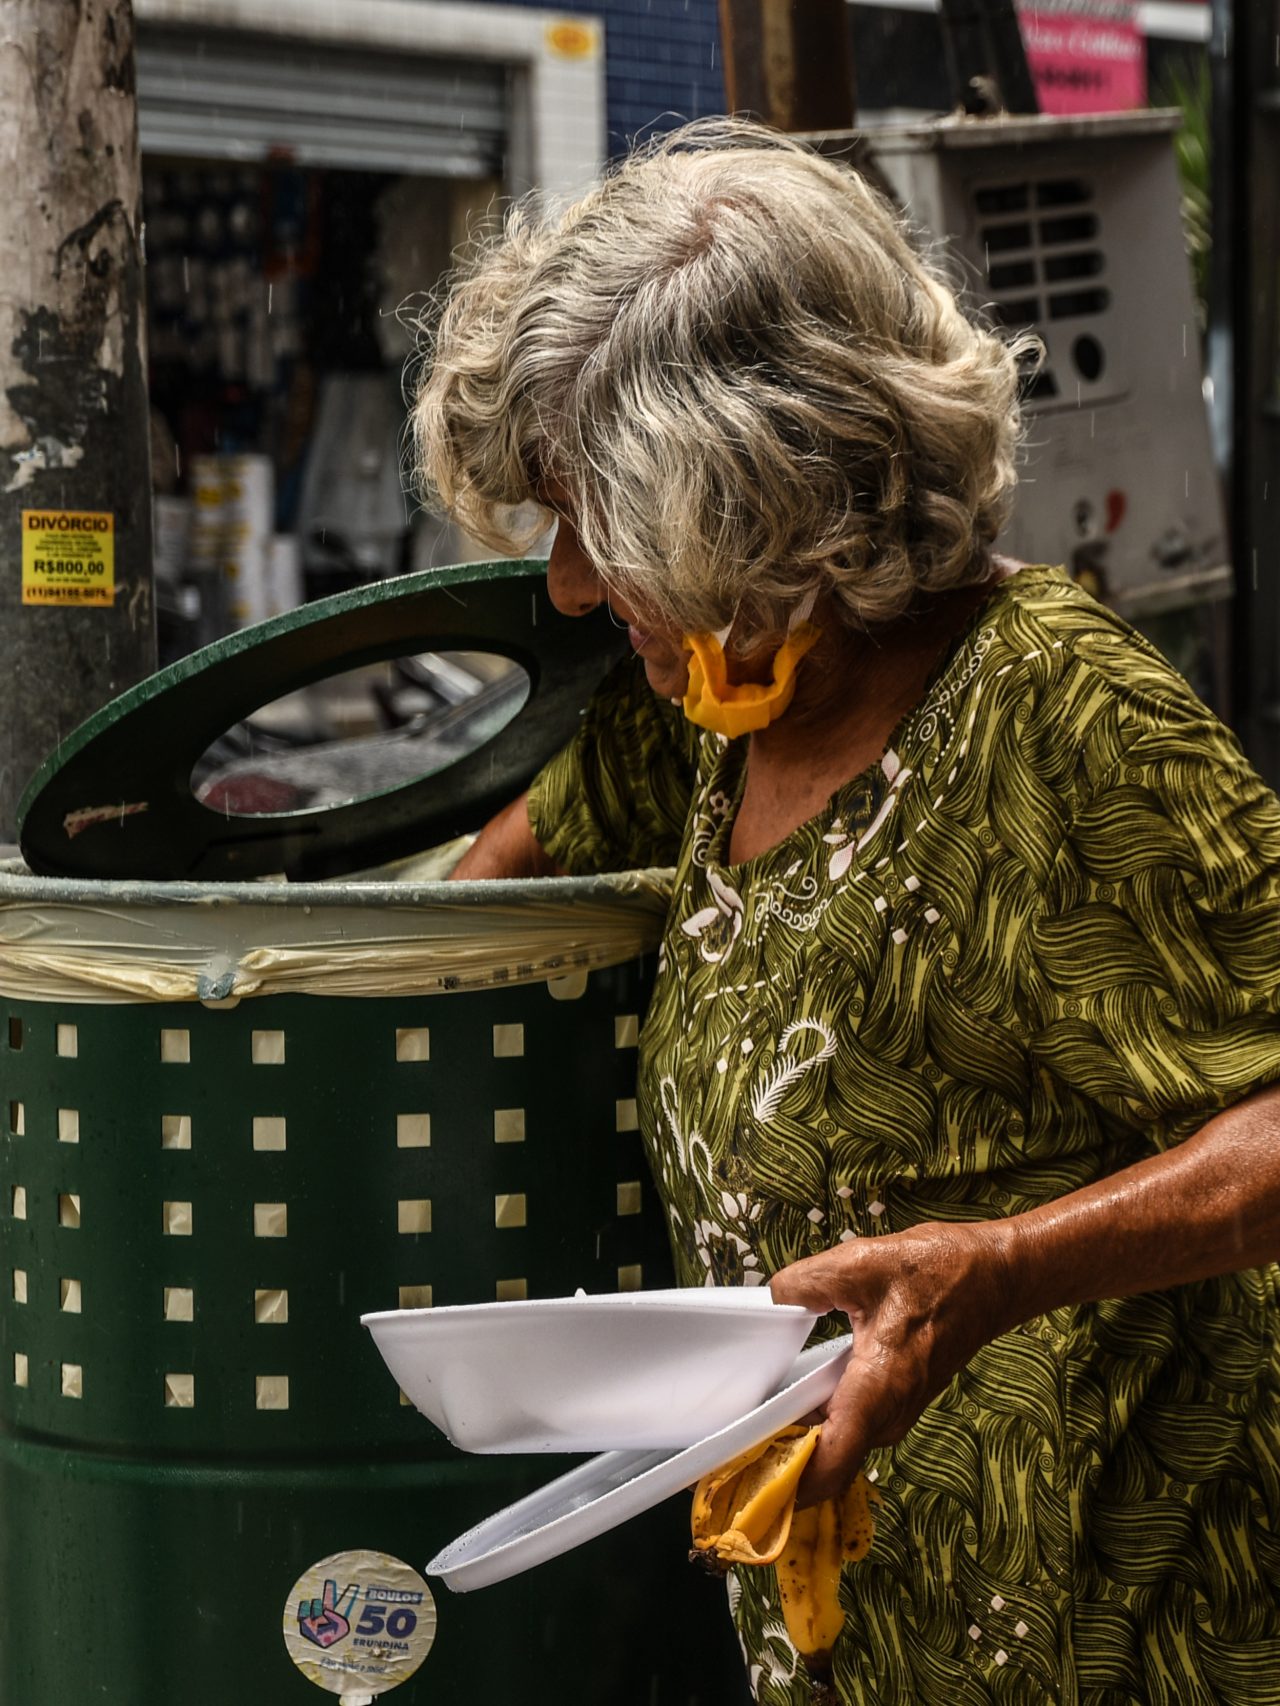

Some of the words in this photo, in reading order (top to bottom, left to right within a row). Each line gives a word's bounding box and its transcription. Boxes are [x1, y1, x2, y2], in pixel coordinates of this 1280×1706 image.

[367, 1589, 420, 1603] BOULOS
[355, 1604, 417, 1639] 50
[352, 1638, 409, 1650] ERUNDINA
